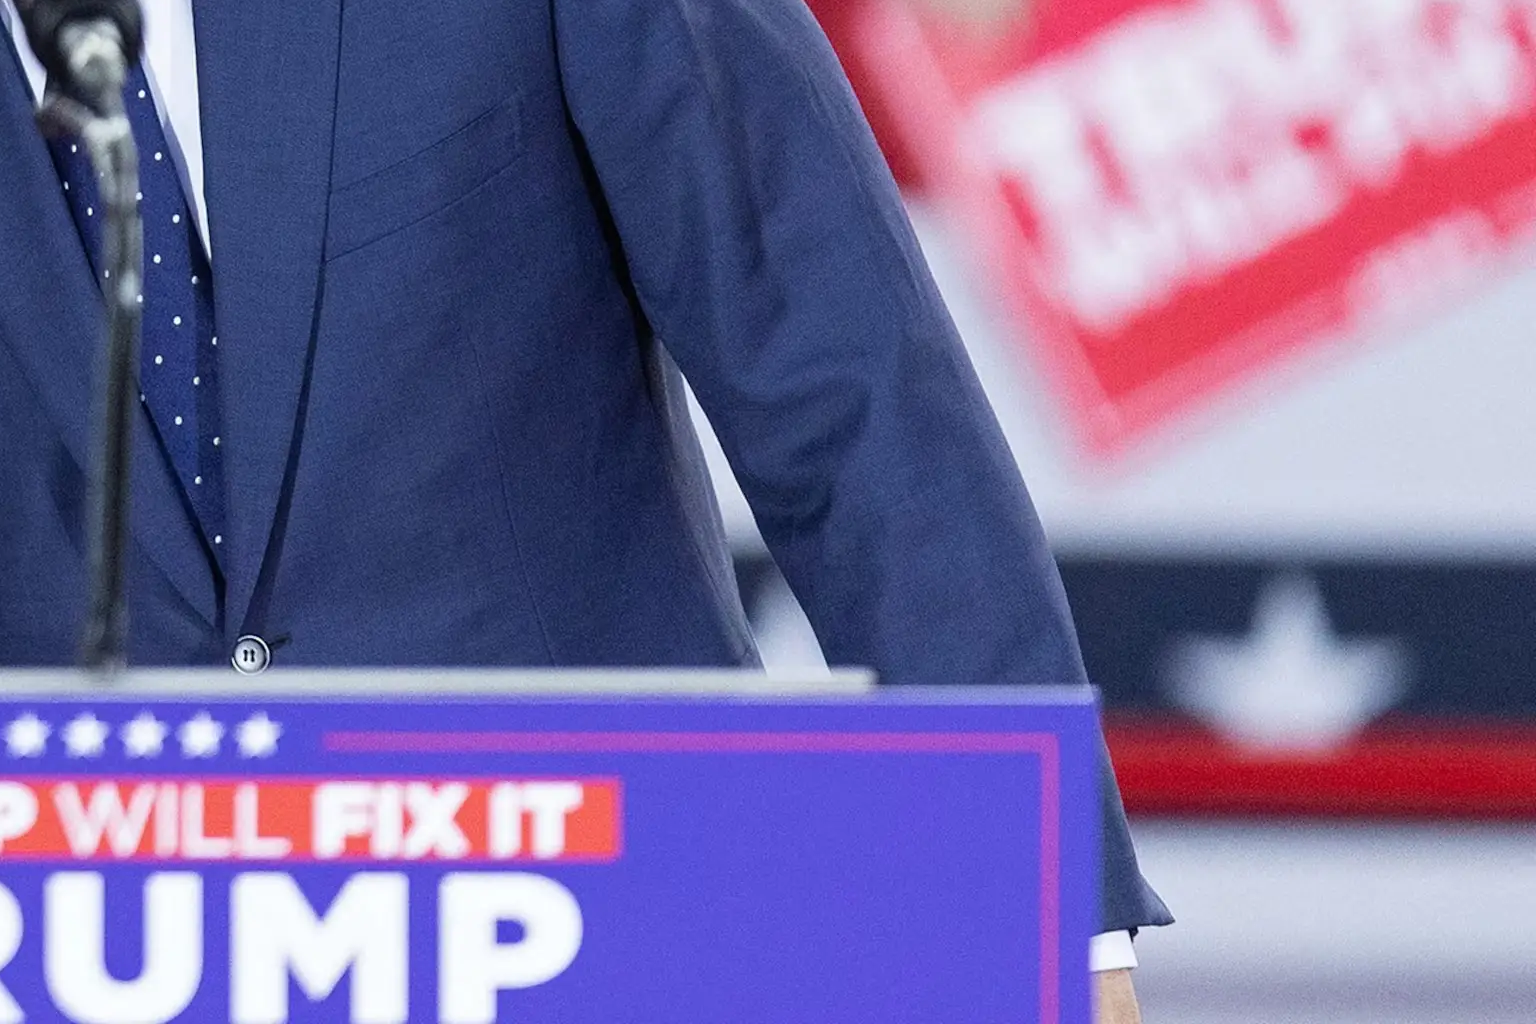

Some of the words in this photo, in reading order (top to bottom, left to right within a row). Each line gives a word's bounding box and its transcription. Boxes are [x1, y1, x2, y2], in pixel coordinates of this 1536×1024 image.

[53, 782, 290, 857] WILL
[311, 782, 470, 857] FIX
[487, 782, 584, 857] IT
